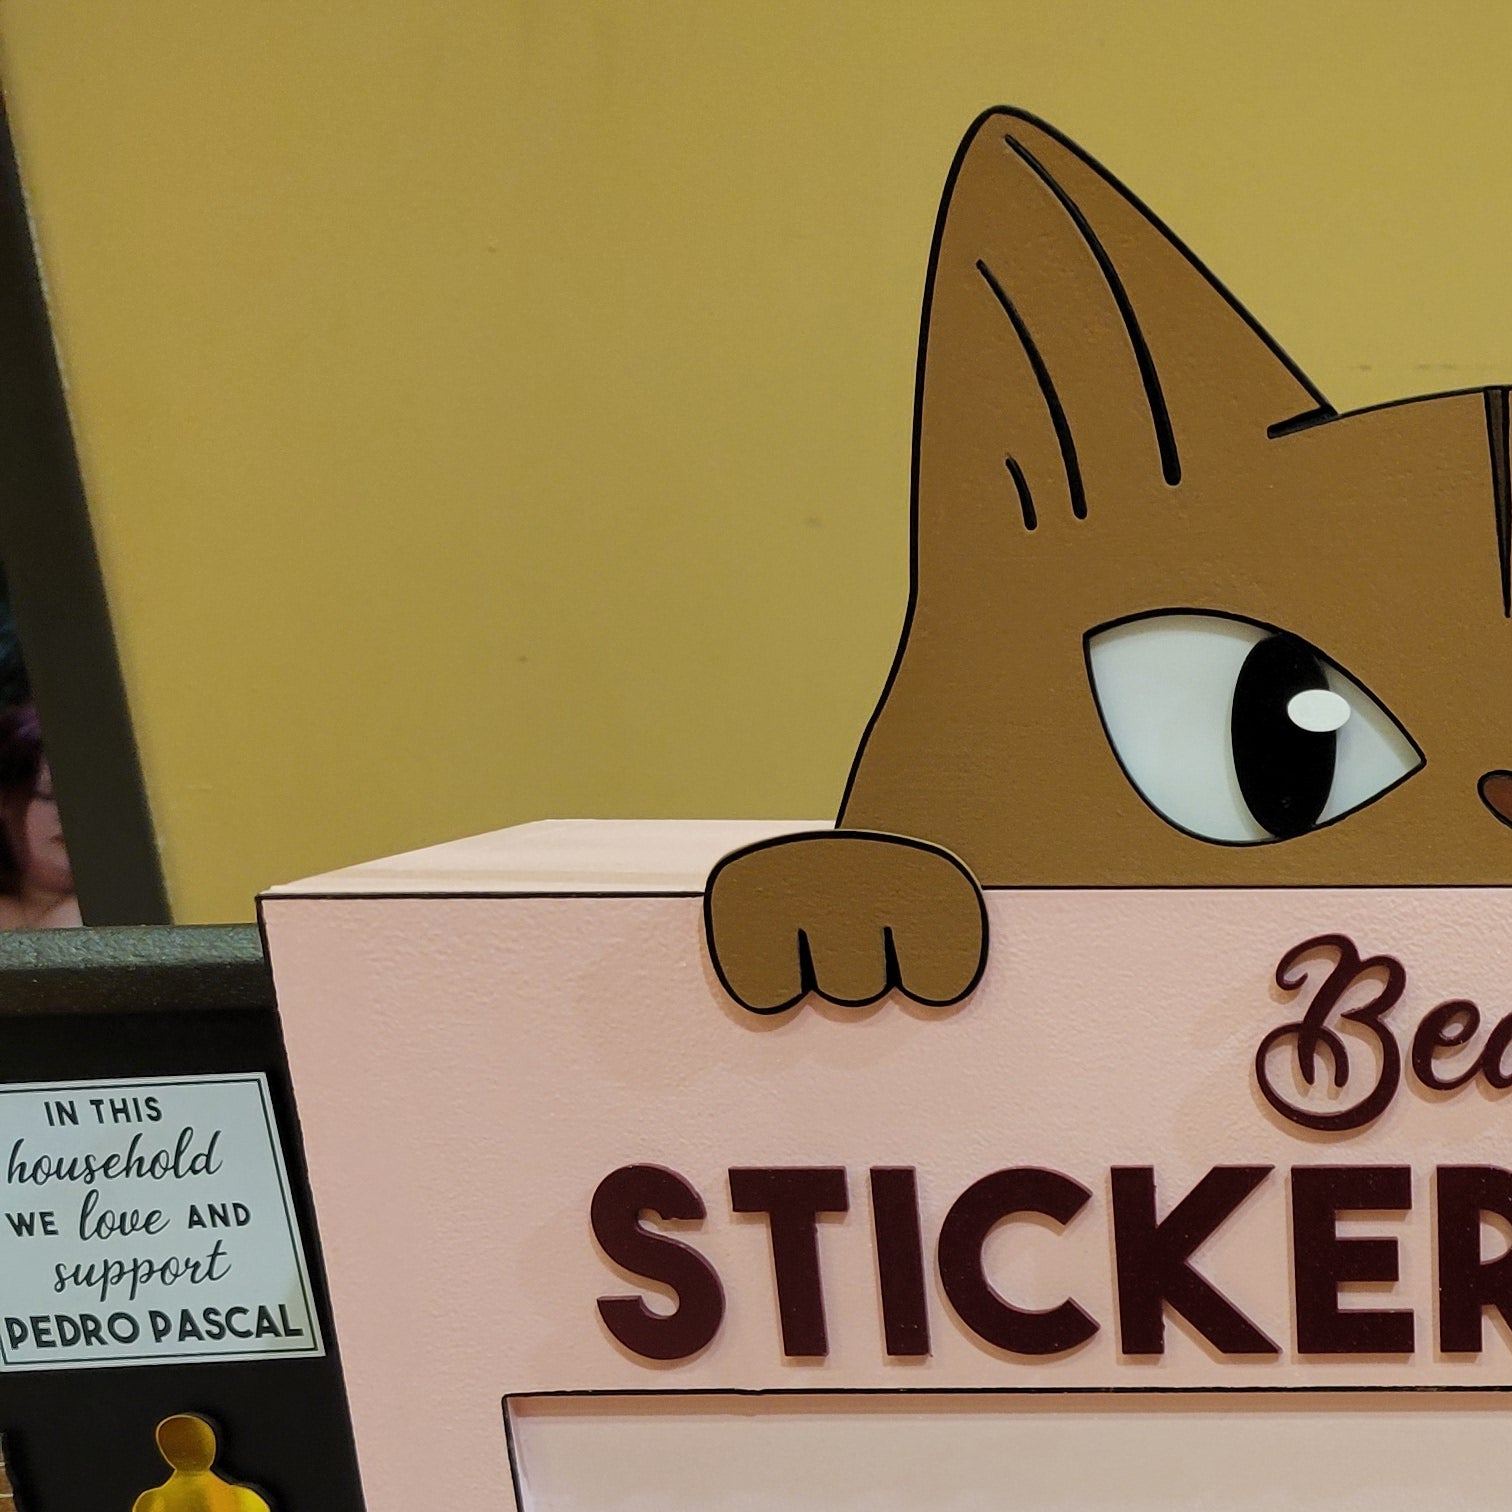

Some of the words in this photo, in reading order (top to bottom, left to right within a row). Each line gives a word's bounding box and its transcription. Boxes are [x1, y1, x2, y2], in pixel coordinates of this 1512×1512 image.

[44, 1100, 79, 1127] IN
[90, 1097, 163, 1124] THIS
[8, 1126, 224, 1186] household
[4, 1211, 59, 1238] WE
[79, 1189, 170, 1241] love
[187, 1202, 252, 1229] AND
[54, 1239, 232, 1302] support
[4, 1311, 140, 1351] PEDRO
[150, 1304, 304, 1343] PASCAL
